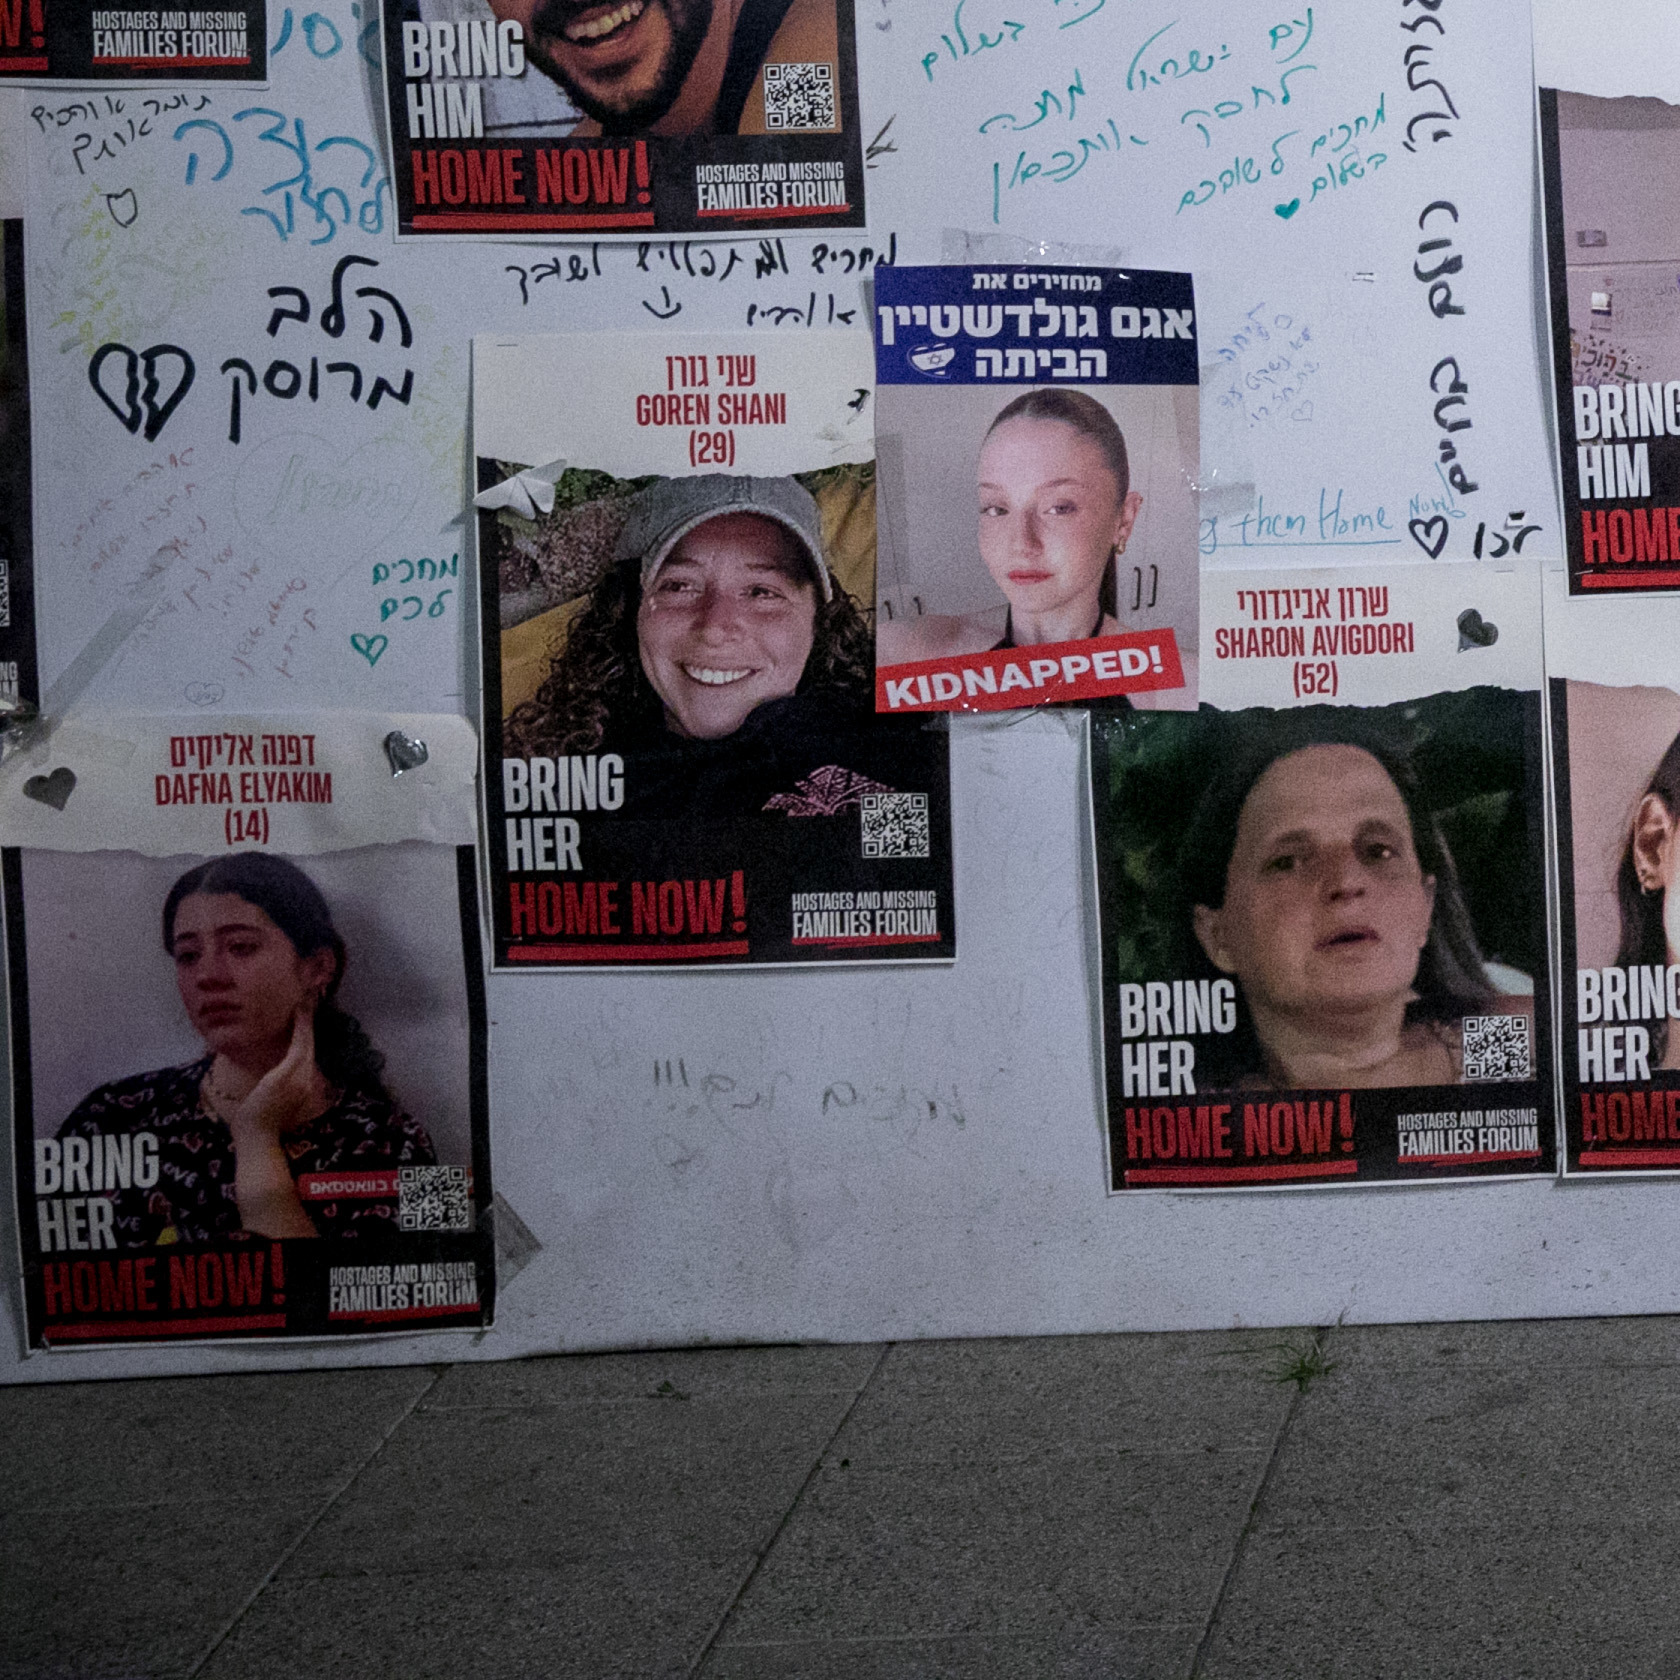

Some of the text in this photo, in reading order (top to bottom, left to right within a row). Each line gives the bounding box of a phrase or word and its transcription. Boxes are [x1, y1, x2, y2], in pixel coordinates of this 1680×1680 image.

[972, 272, 1102, 292] מחזירים את
[266, 254, 413, 349] הלב
[878, 297, 1197, 347] אגם גולדשטיין
[975, 348, 1108, 378] הביתה
[219, 354, 415, 446] מרוסק
[635, 393, 786, 427] GOREN SHANI
[688, 430, 736, 467] (29)
[1214, 621, 1415, 660] SHARON AVIGDORI
[883, 644, 1166, 708] KIDNAPPED!
[1292, 661, 1339, 698] (52)
[154, 771, 332, 806] DAFNA ELYAKIM
[223, 807, 270, 845] (14)
